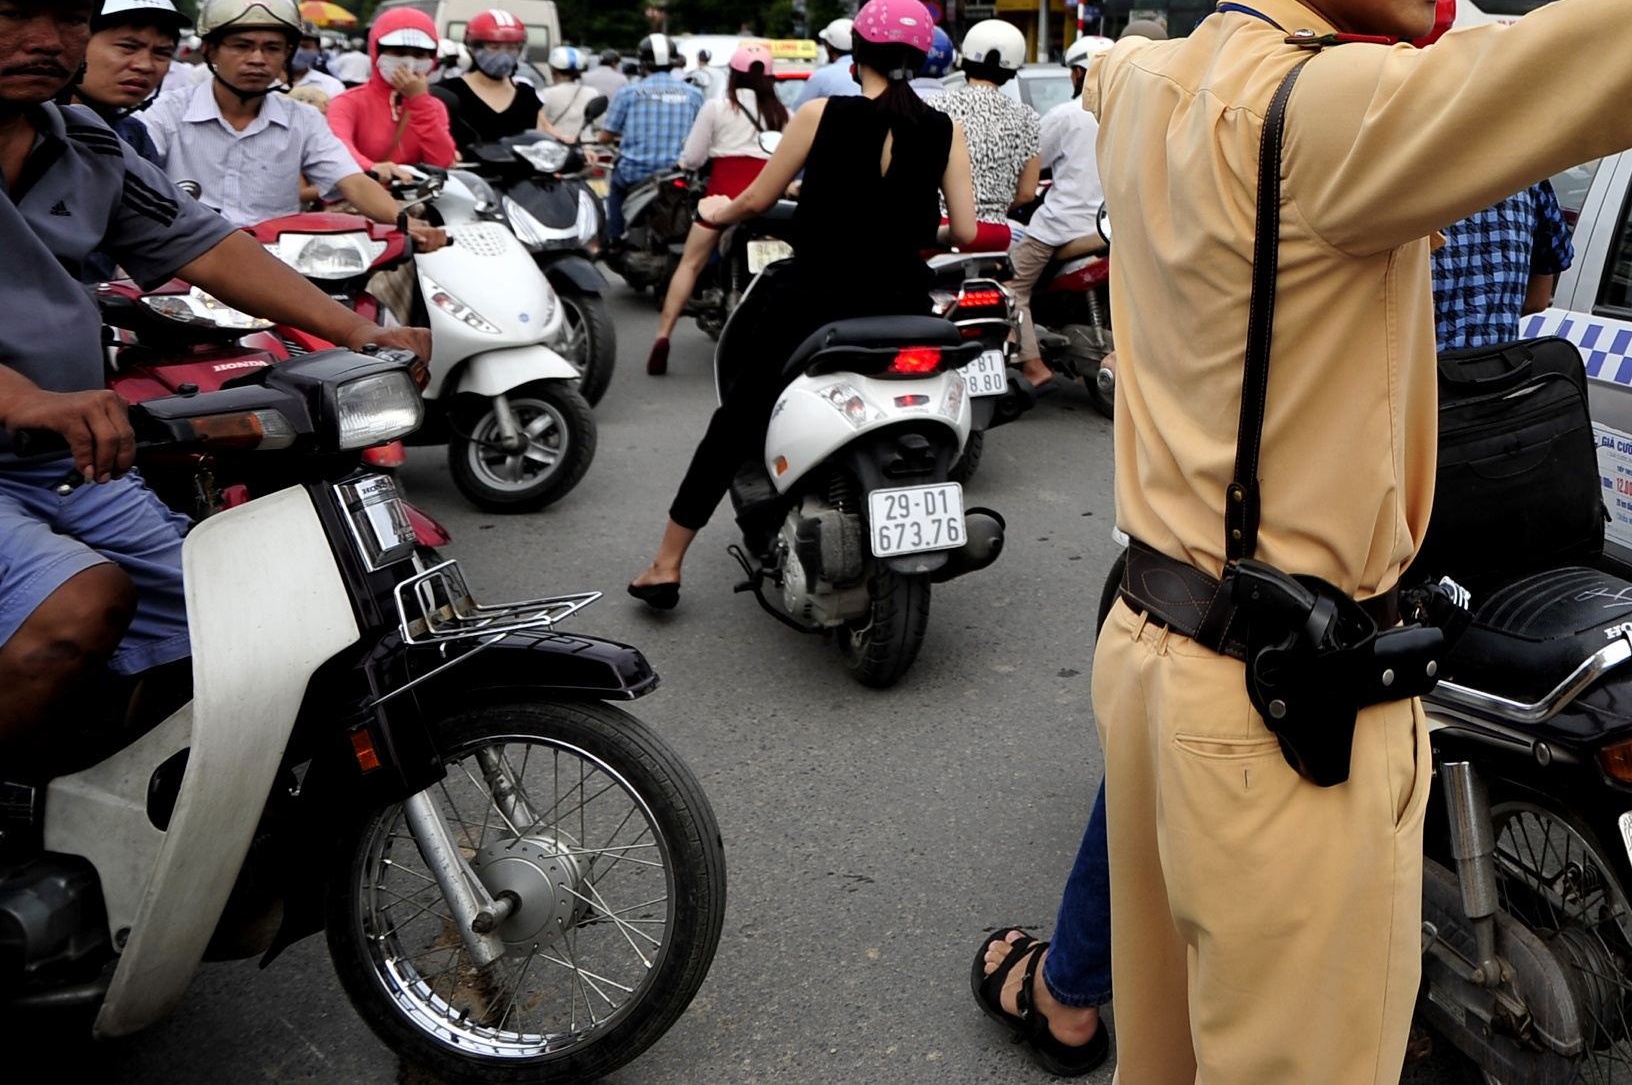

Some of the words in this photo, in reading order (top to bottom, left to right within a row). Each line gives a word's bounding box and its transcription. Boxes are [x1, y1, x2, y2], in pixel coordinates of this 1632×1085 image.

[213, 360, 269, 372] HONDA
[1602, 436, 1615, 450] GIÁ
[884, 489, 948, 521] 29-D1
[878, 517, 959, 551] 673.76
